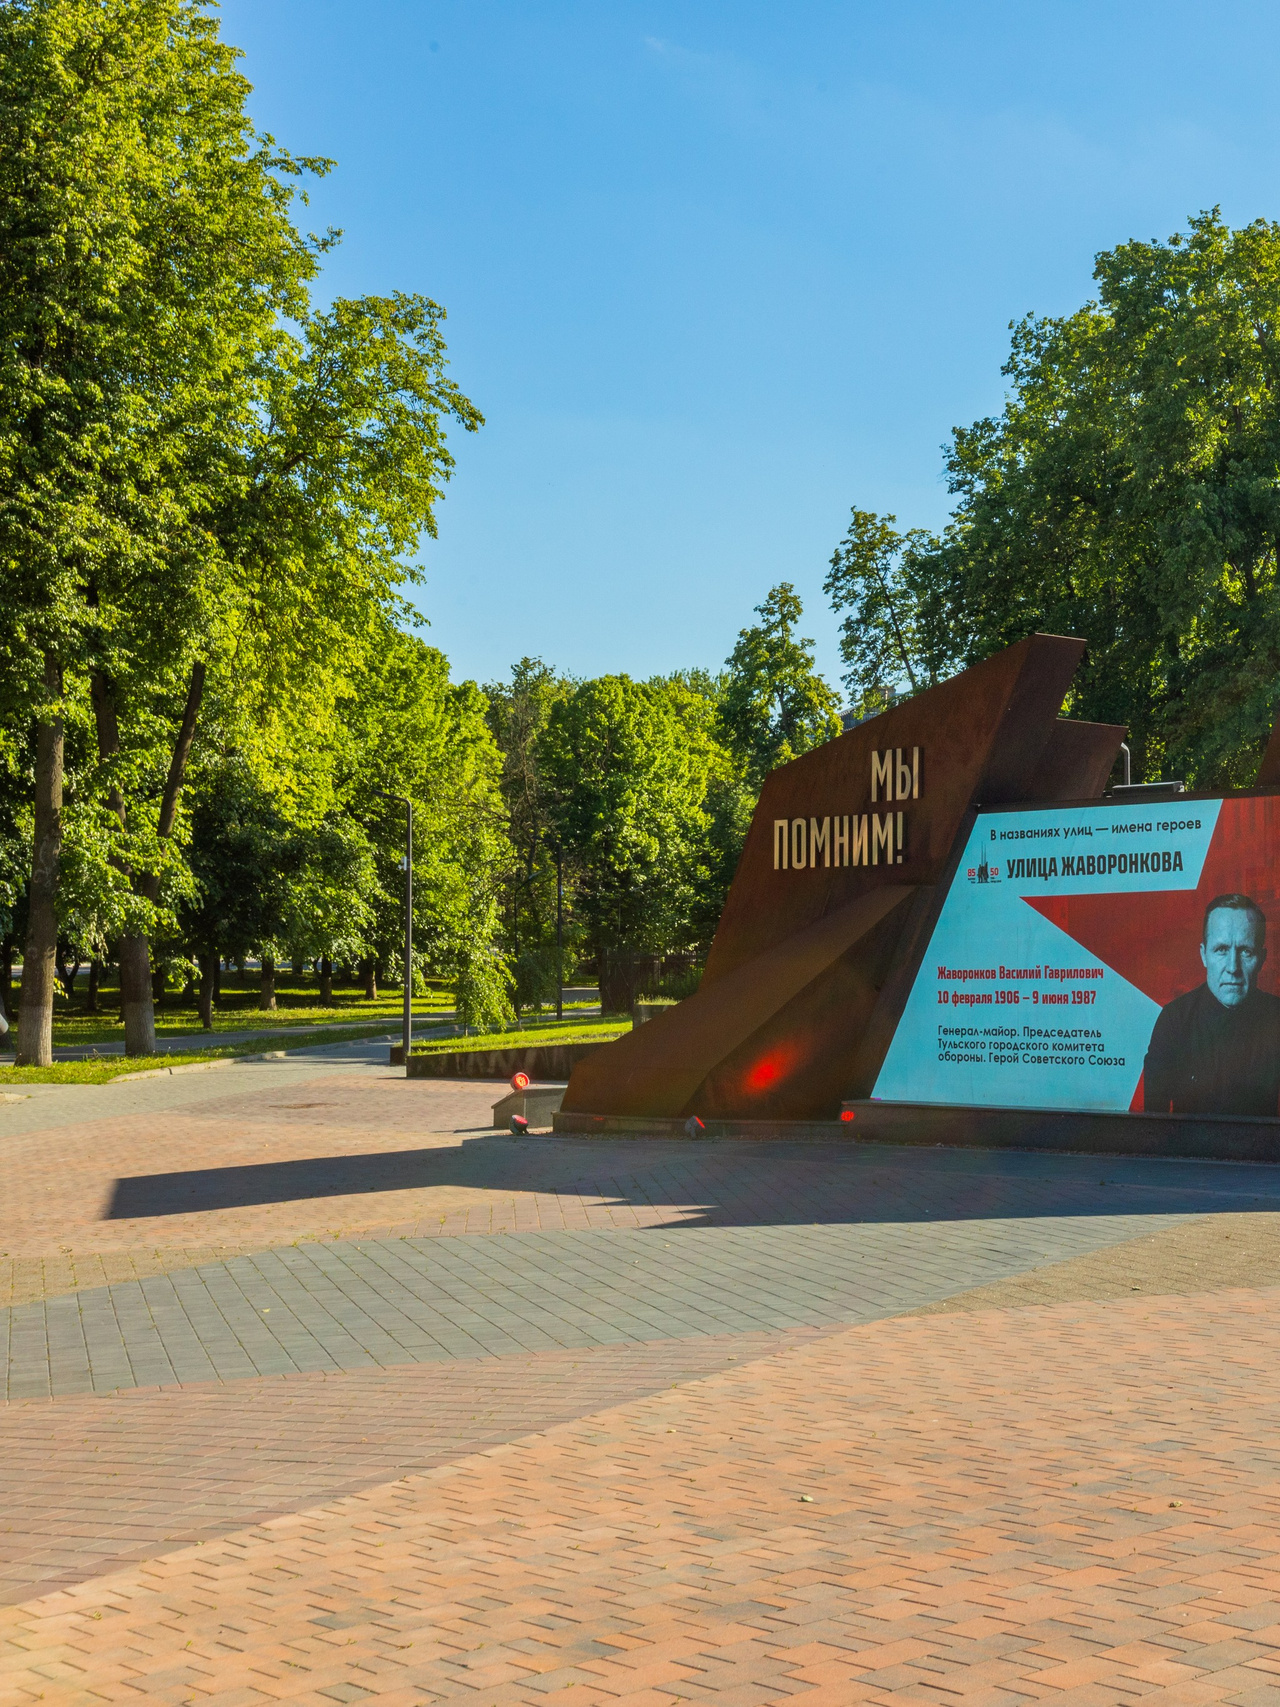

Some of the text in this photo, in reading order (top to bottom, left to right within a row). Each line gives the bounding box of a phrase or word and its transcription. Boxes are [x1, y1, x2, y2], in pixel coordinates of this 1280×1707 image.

[871, 746, 920, 802] МЫ
[990, 829, 997, 841] В
[1000, 826, 1060, 841] названиях
[1063, 824, 1093, 840] улиц
[1111, 821, 1151, 834] имена
[1156, 819, 1202, 834] героев
[773, 811, 904, 870] ПОМНИМ!
[967, 868, 976, 877] 85
[990, 867, 999, 876] 50
[1006, 851, 1184, 881] УЛИЦА ЖАВОРОНКОВА
[937, 965, 1104, 983] Жаворонков Василий Гаврилович
[937, 990, 949, 1004] 10
[951, 990, 993, 1007] февраля
[994, 990, 1020, 1004] 1906
[1032, 990, 1039, 1004] 9
[1042, 993, 1069, 1005] июня
[1071, 990, 1097, 1005] 1987
[938, 1025, 1102, 1039] Генерал-майор. Председатель
[937, 1038, 1105, 1053] Тульского городского комитета
[937, 1051, 1126, 1066] обороны. Герой Советского Союза
